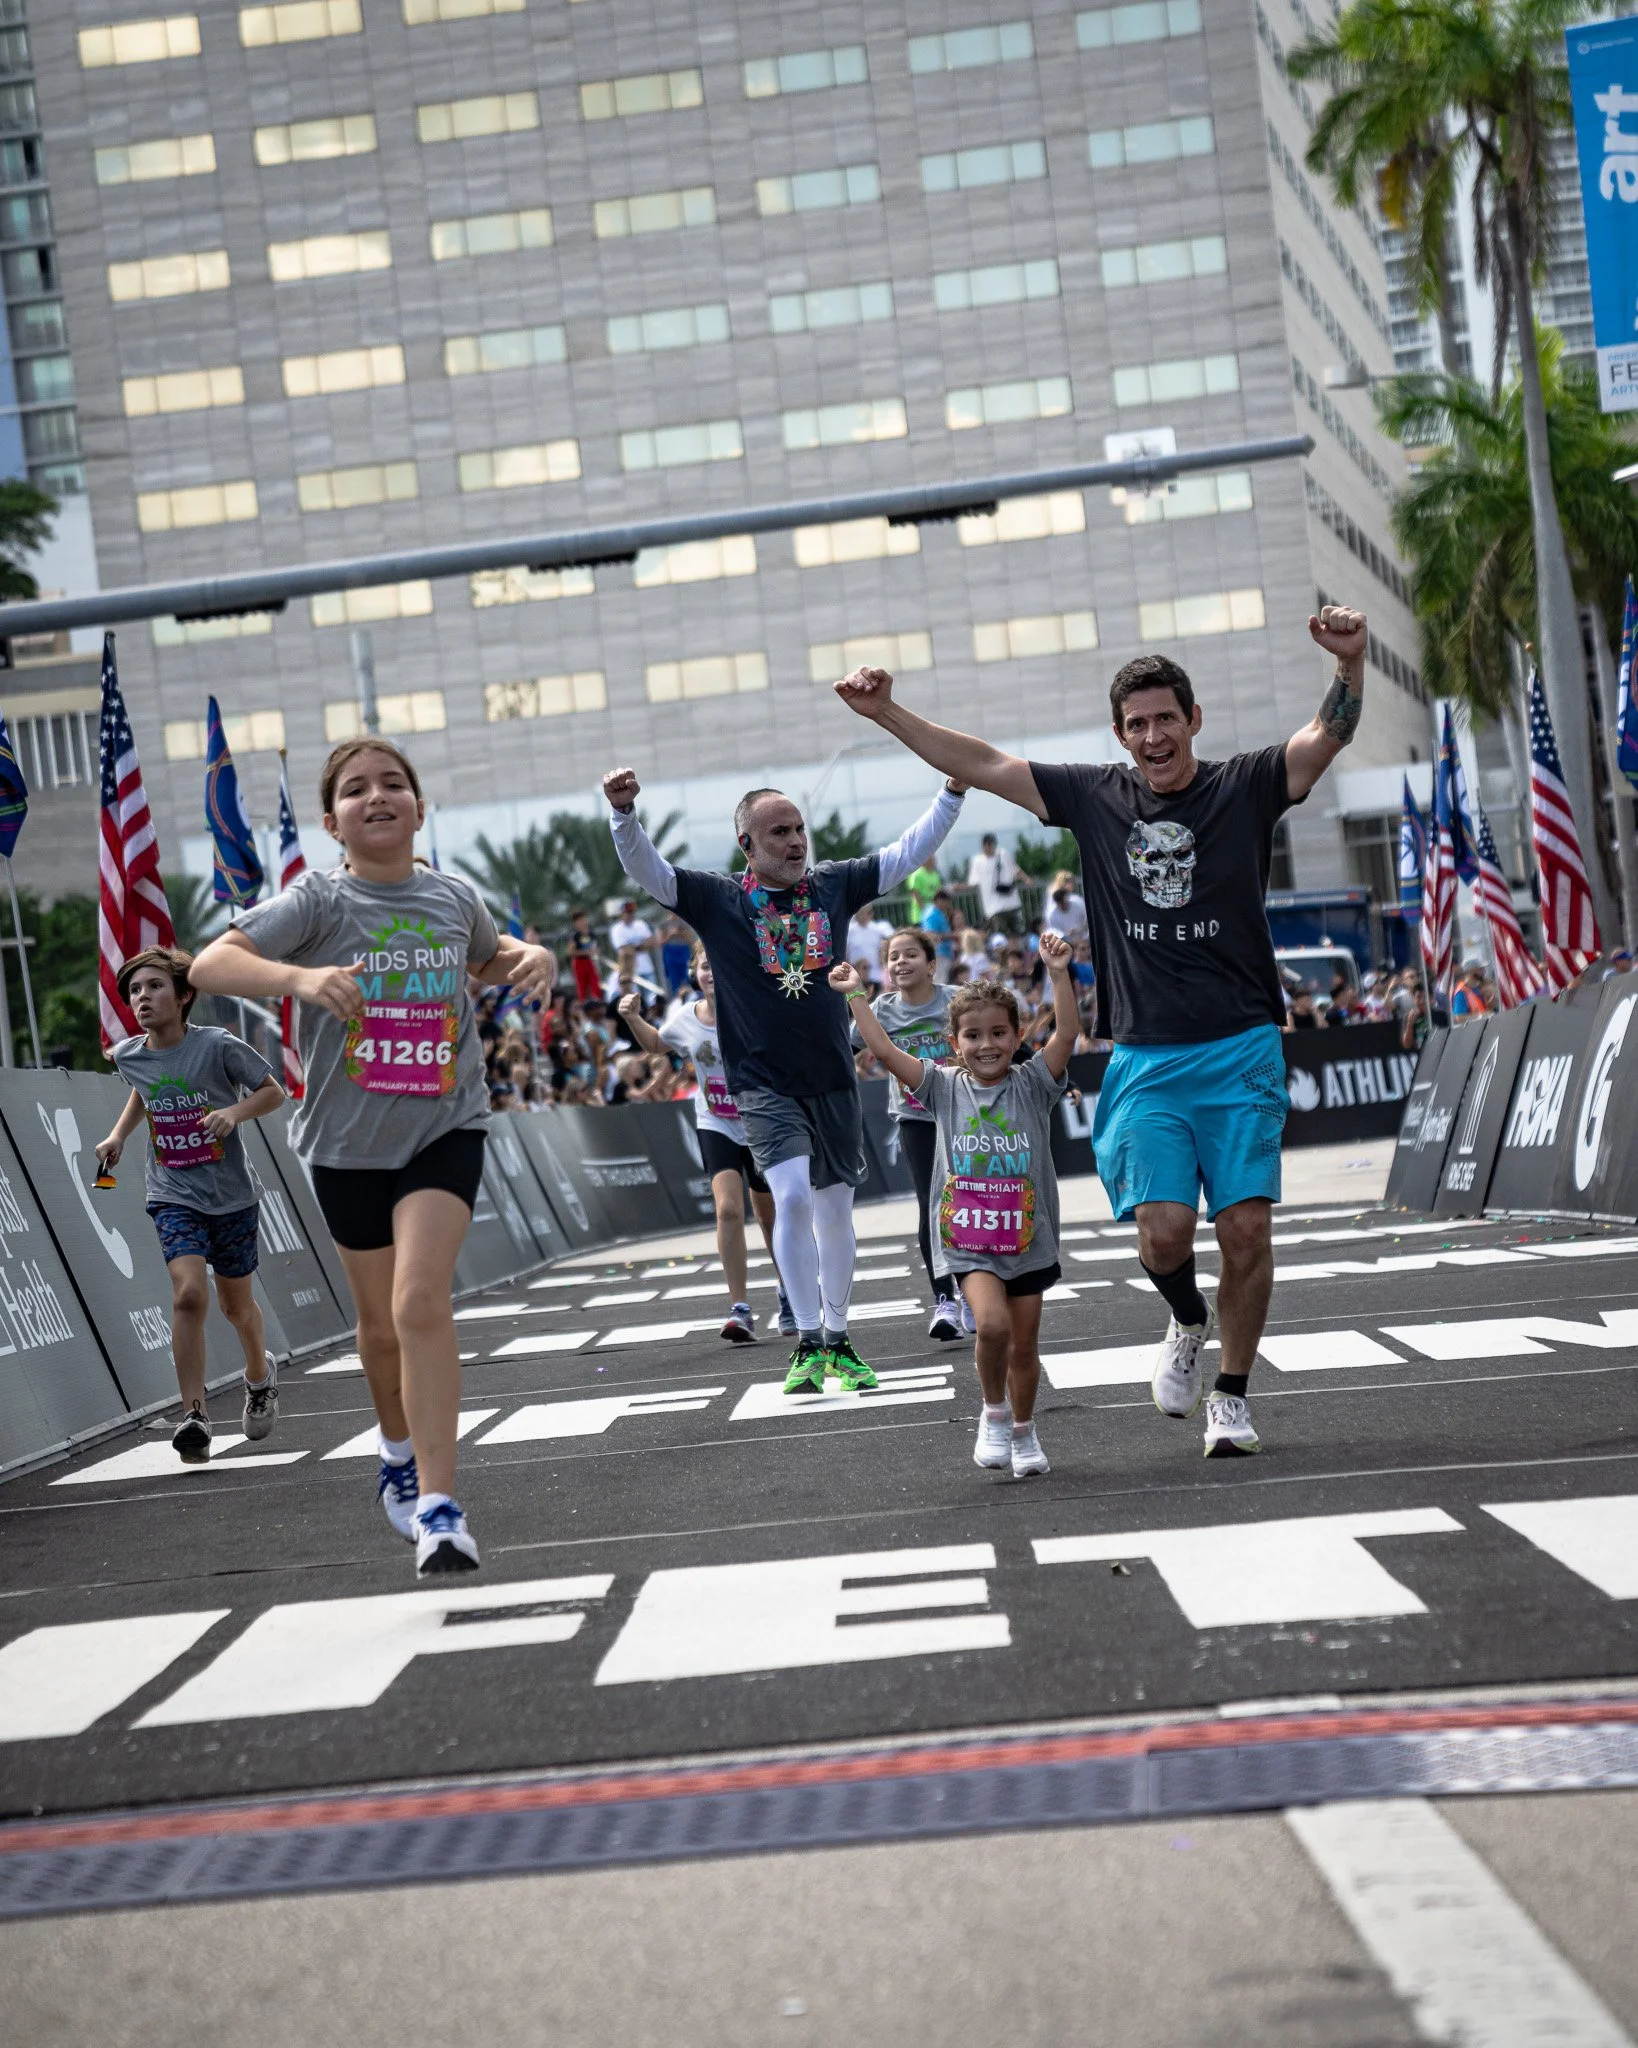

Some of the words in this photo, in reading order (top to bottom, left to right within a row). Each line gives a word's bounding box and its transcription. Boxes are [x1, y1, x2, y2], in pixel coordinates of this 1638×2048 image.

[1124, 919, 1159, 940] THE
[1176, 919, 1220, 941] END
[353, 951, 409, 973] KIDS
[414, 946, 460, 970] RUN
[410, 1008, 447, 1020] MIAMI
[353, 1038, 453, 1066] 41266
[176, 1090, 209, 1109] RUN
[176, 1110, 206, 1123] MIAMI
[156, 1129, 217, 1150] 41262
[951, 1135, 991, 1152] KIDS
[995, 1132, 1030, 1152] RUN
[988, 1183, 1024, 1193] MIAMI
[952, 1208, 1023, 1230] 41311
[0, 1259, 75, 1350] Health
[129, 1305, 173, 1352] CELSIUS
